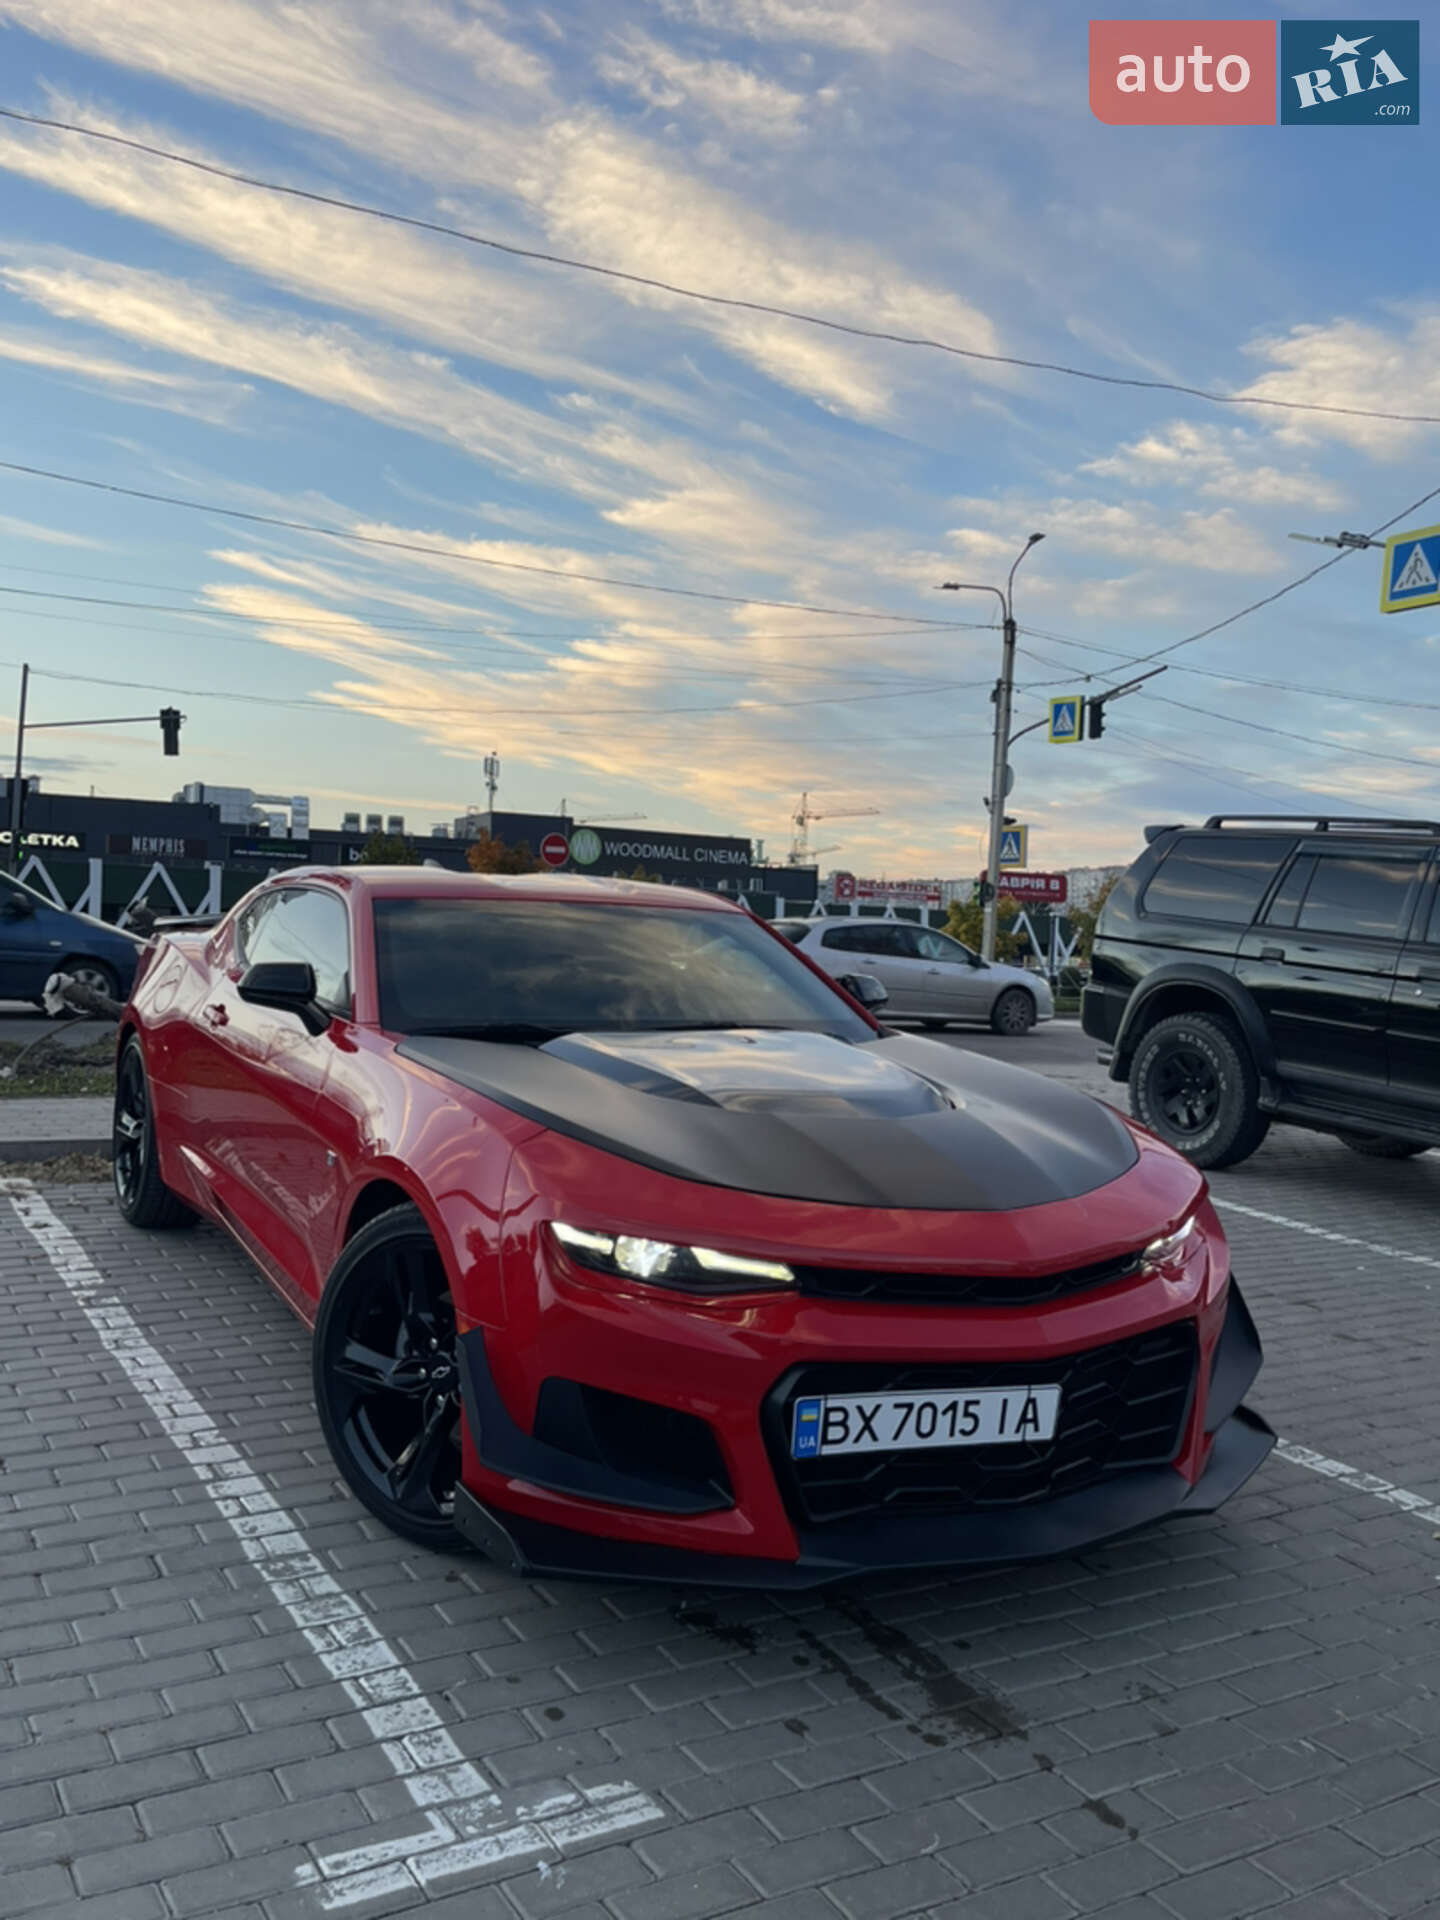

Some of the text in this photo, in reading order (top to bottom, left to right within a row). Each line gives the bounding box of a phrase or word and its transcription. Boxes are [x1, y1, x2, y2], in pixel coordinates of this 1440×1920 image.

[131, 836, 185, 854] MEMPHIS
[604, 841, 690, 861] WOODMALL
[694, 848, 748, 865] CINEMA
[1000, 876, 1045, 889] АВРІЯ
[822, 1397, 1040, 1446] BX 7015 IA
[799, 1435, 816, 1449] UA
